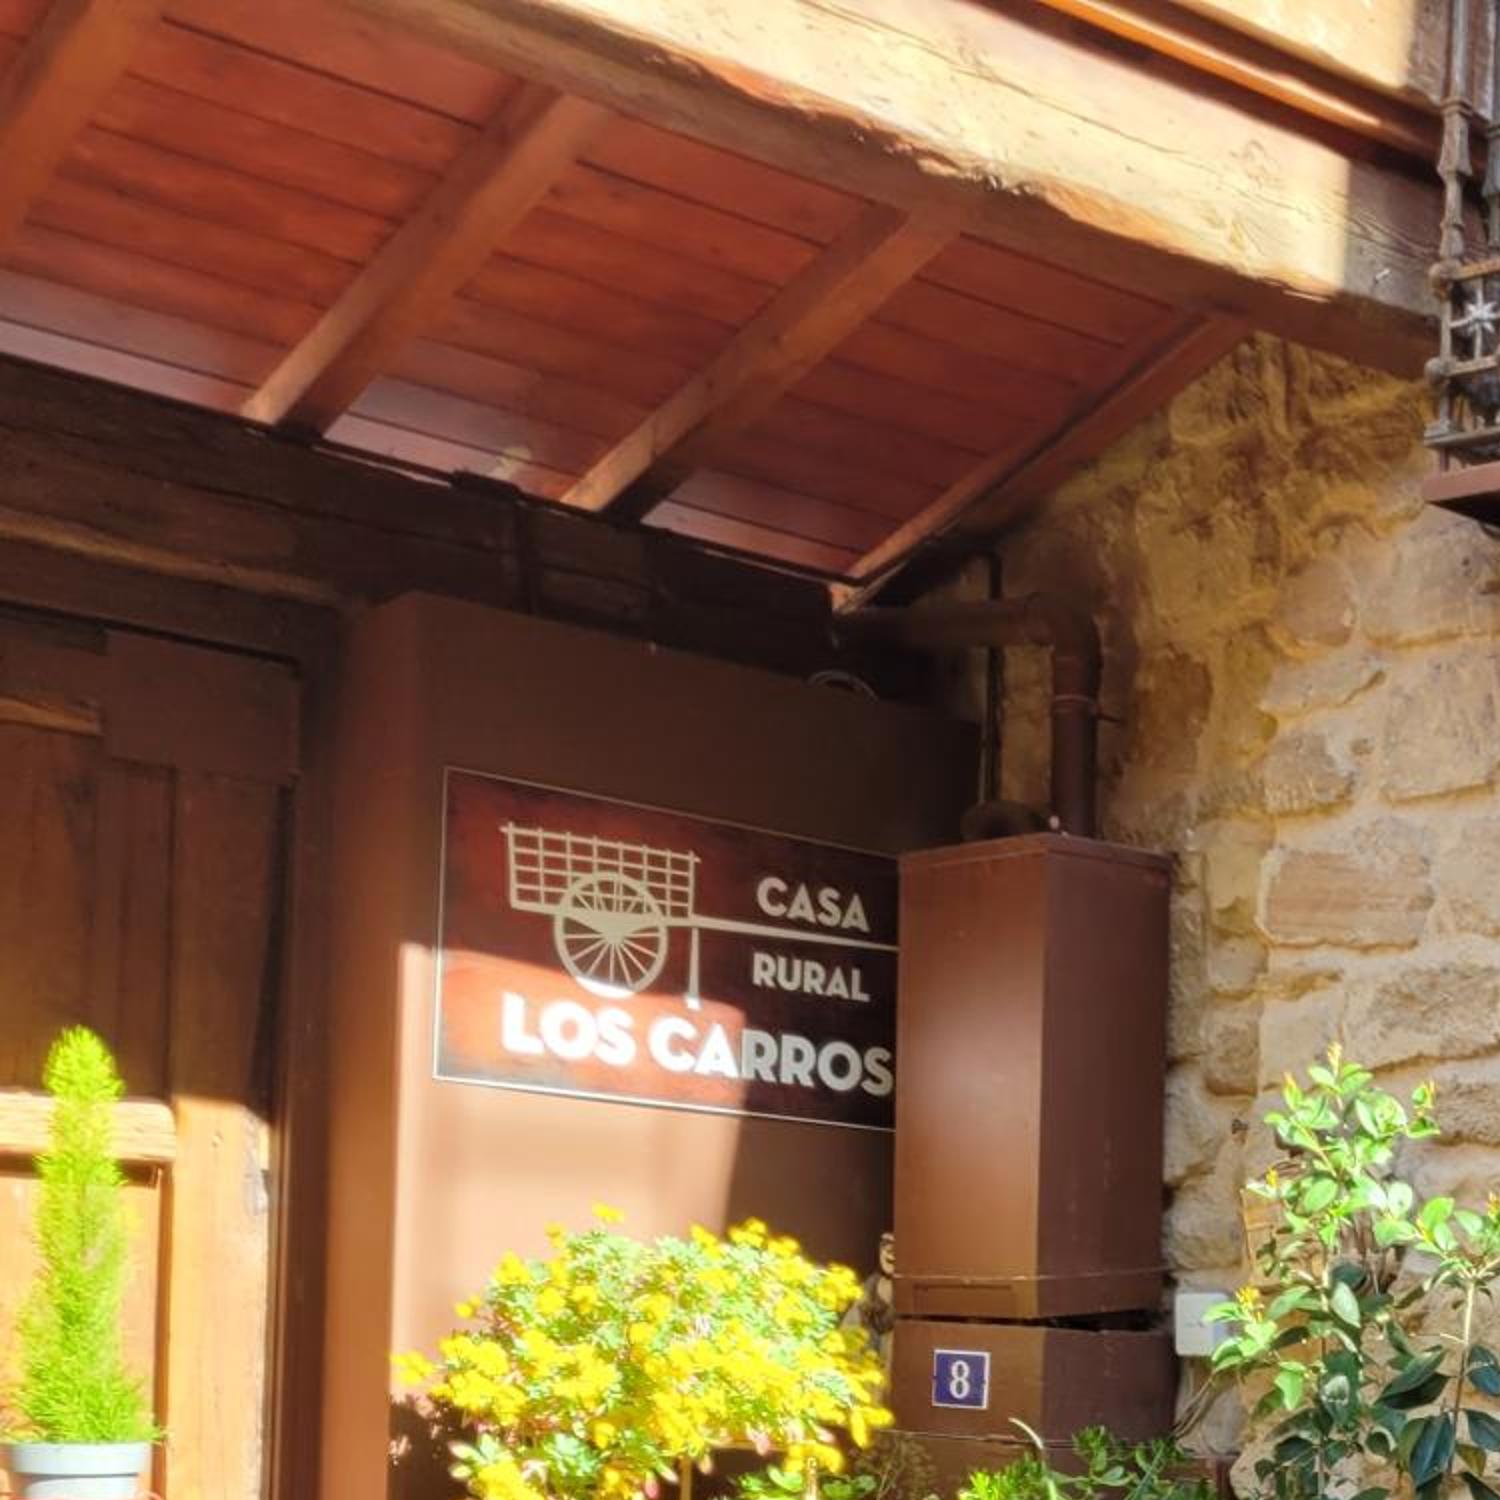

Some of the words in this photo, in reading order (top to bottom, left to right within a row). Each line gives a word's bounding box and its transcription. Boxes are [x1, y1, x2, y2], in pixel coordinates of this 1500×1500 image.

[756, 876, 870, 933] CASA
[752, 952, 870, 1002] RURAL
[501, 992, 636, 1066] LOS
[647, 1014, 895, 1097] CARROS
[950, 1360, 970, 1399] 8
